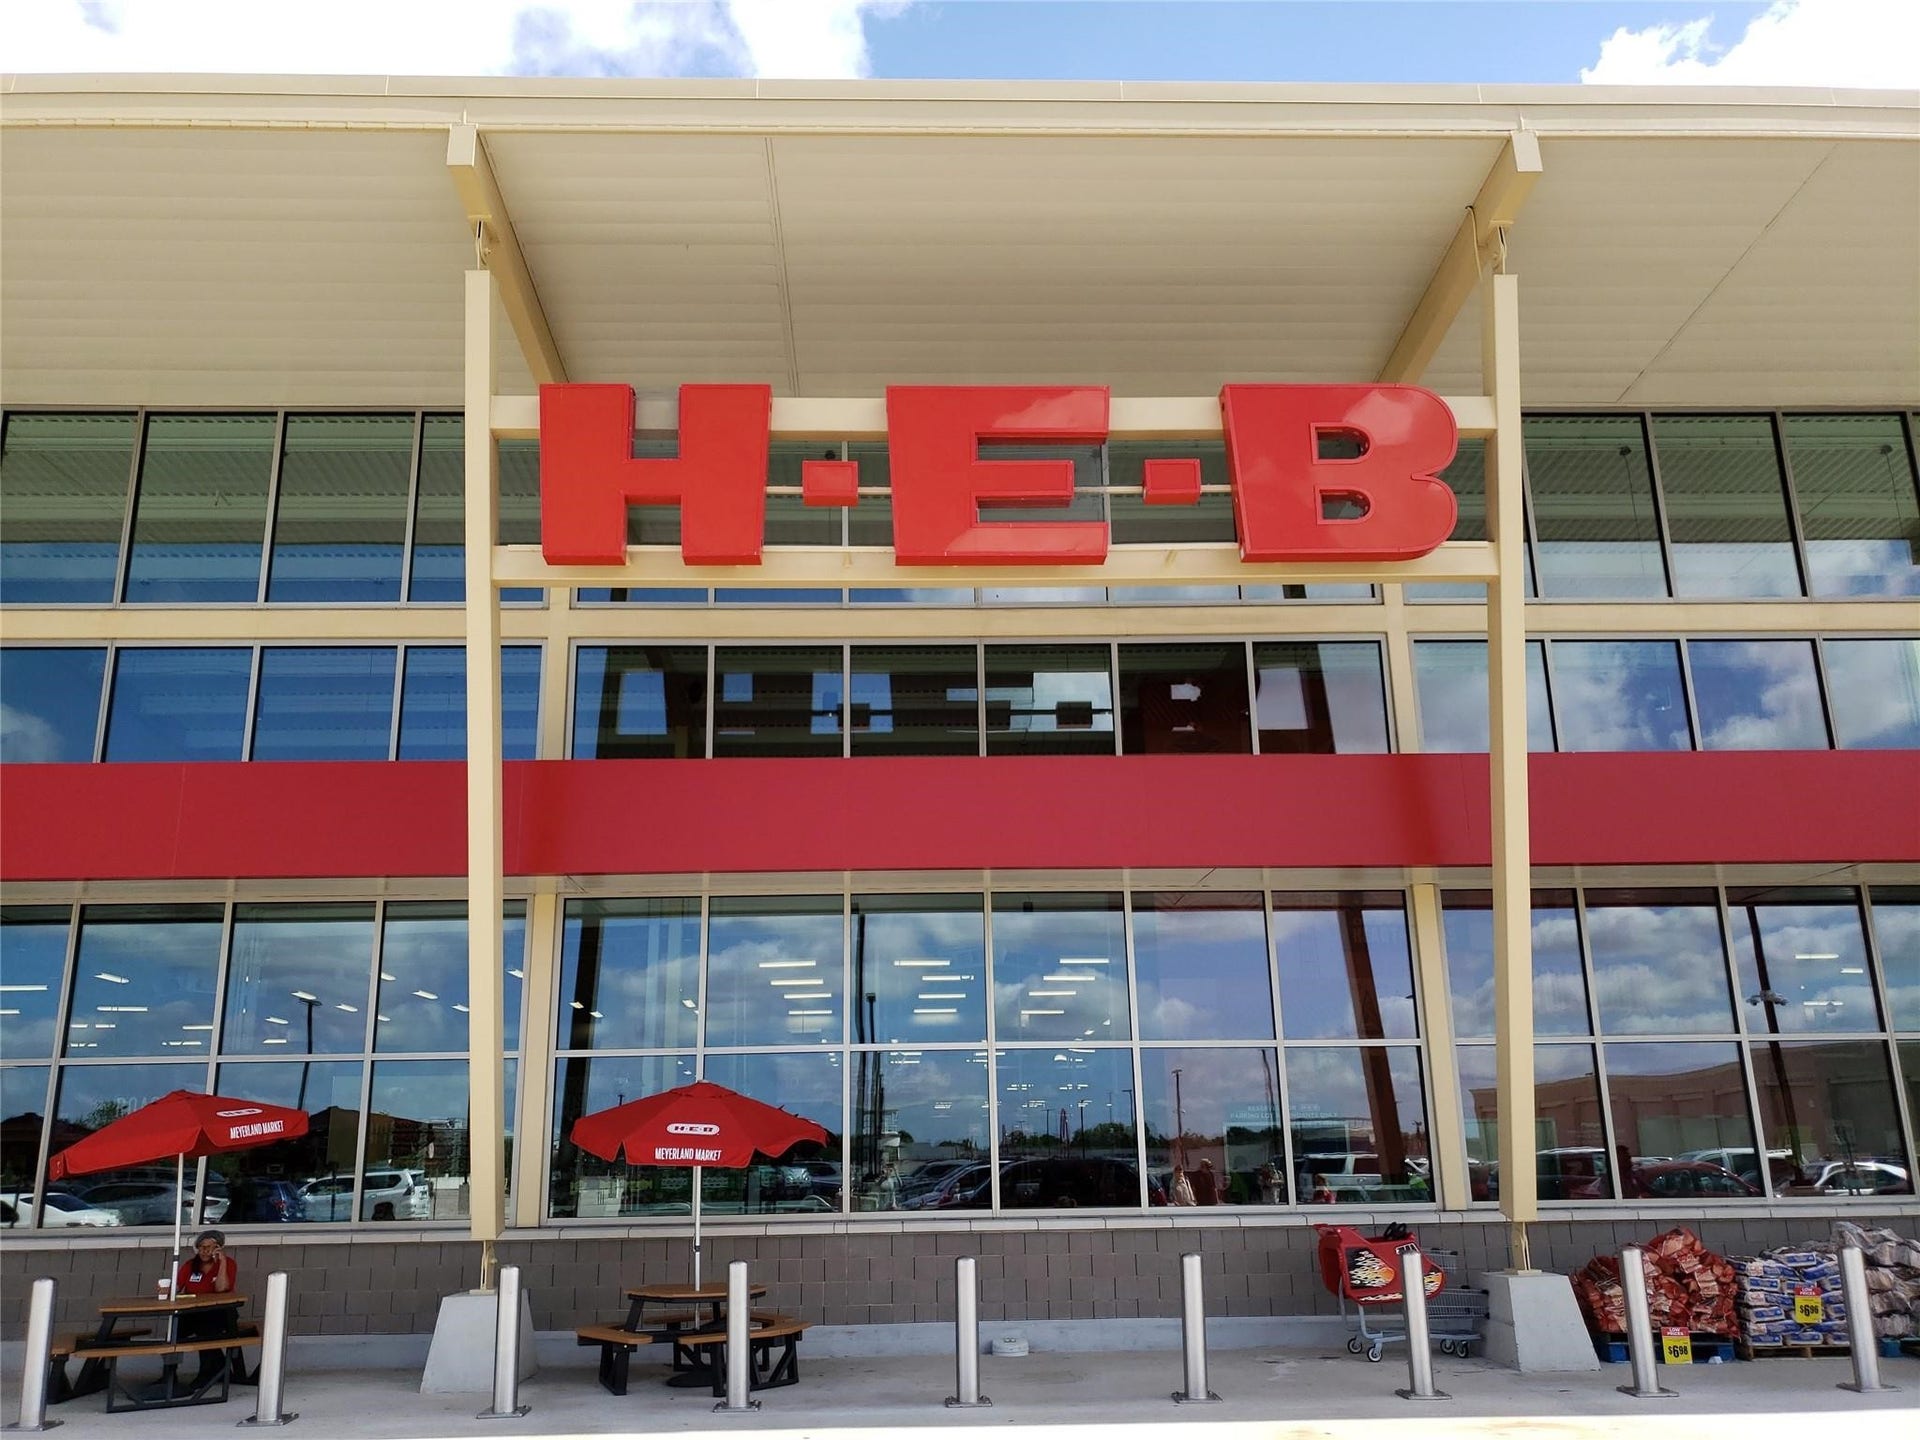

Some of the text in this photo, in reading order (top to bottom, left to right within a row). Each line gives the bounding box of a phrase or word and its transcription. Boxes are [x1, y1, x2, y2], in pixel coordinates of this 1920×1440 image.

[540, 383, 1458, 566] H-E-B
[230, 1120, 284, 1139] MEYERLAND MARKET
[655, 1148, 721, 1161] MEYERLAND MARKET
